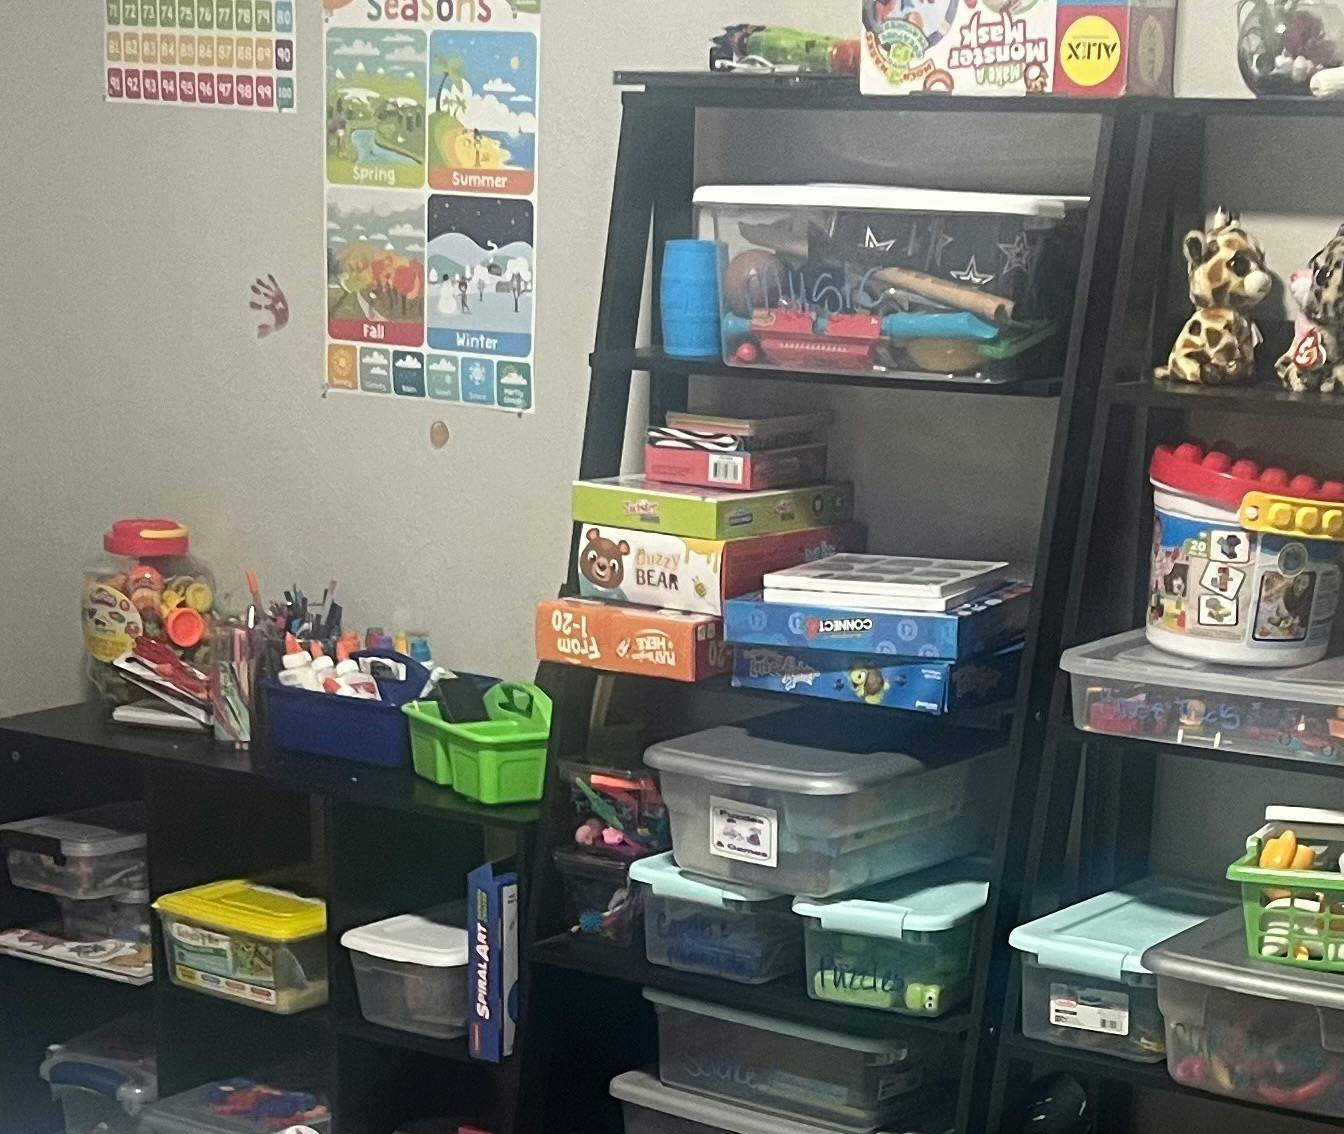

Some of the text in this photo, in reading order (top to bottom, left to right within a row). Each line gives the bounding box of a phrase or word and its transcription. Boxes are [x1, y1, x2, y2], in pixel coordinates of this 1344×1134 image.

[960, 11, 1026, 46] Mask
[278, 47, 291, 62] 90
[948, 39, 1048, 68] Monster
[110, 76, 292, 100] 91 92 93 94 95 96 97 98 99 100
[352, 166, 396, 185] Spring
[452, 171, 508, 188] Summer
[362, 323, 386, 341] Fall
[456, 334, 499, 350] Winter
[1189, 540, 1207, 551] 20
[635, 570, 680, 591] BEAR
[551, 609, 589, 639] 1-20
[819, 617, 873, 635] CONNECT
[557, 637, 602, 660] From
[475, 921, 492, 961] ART
[819, 954, 906, 993] Puzzles
[475, 961, 492, 1020] SPIRAL
